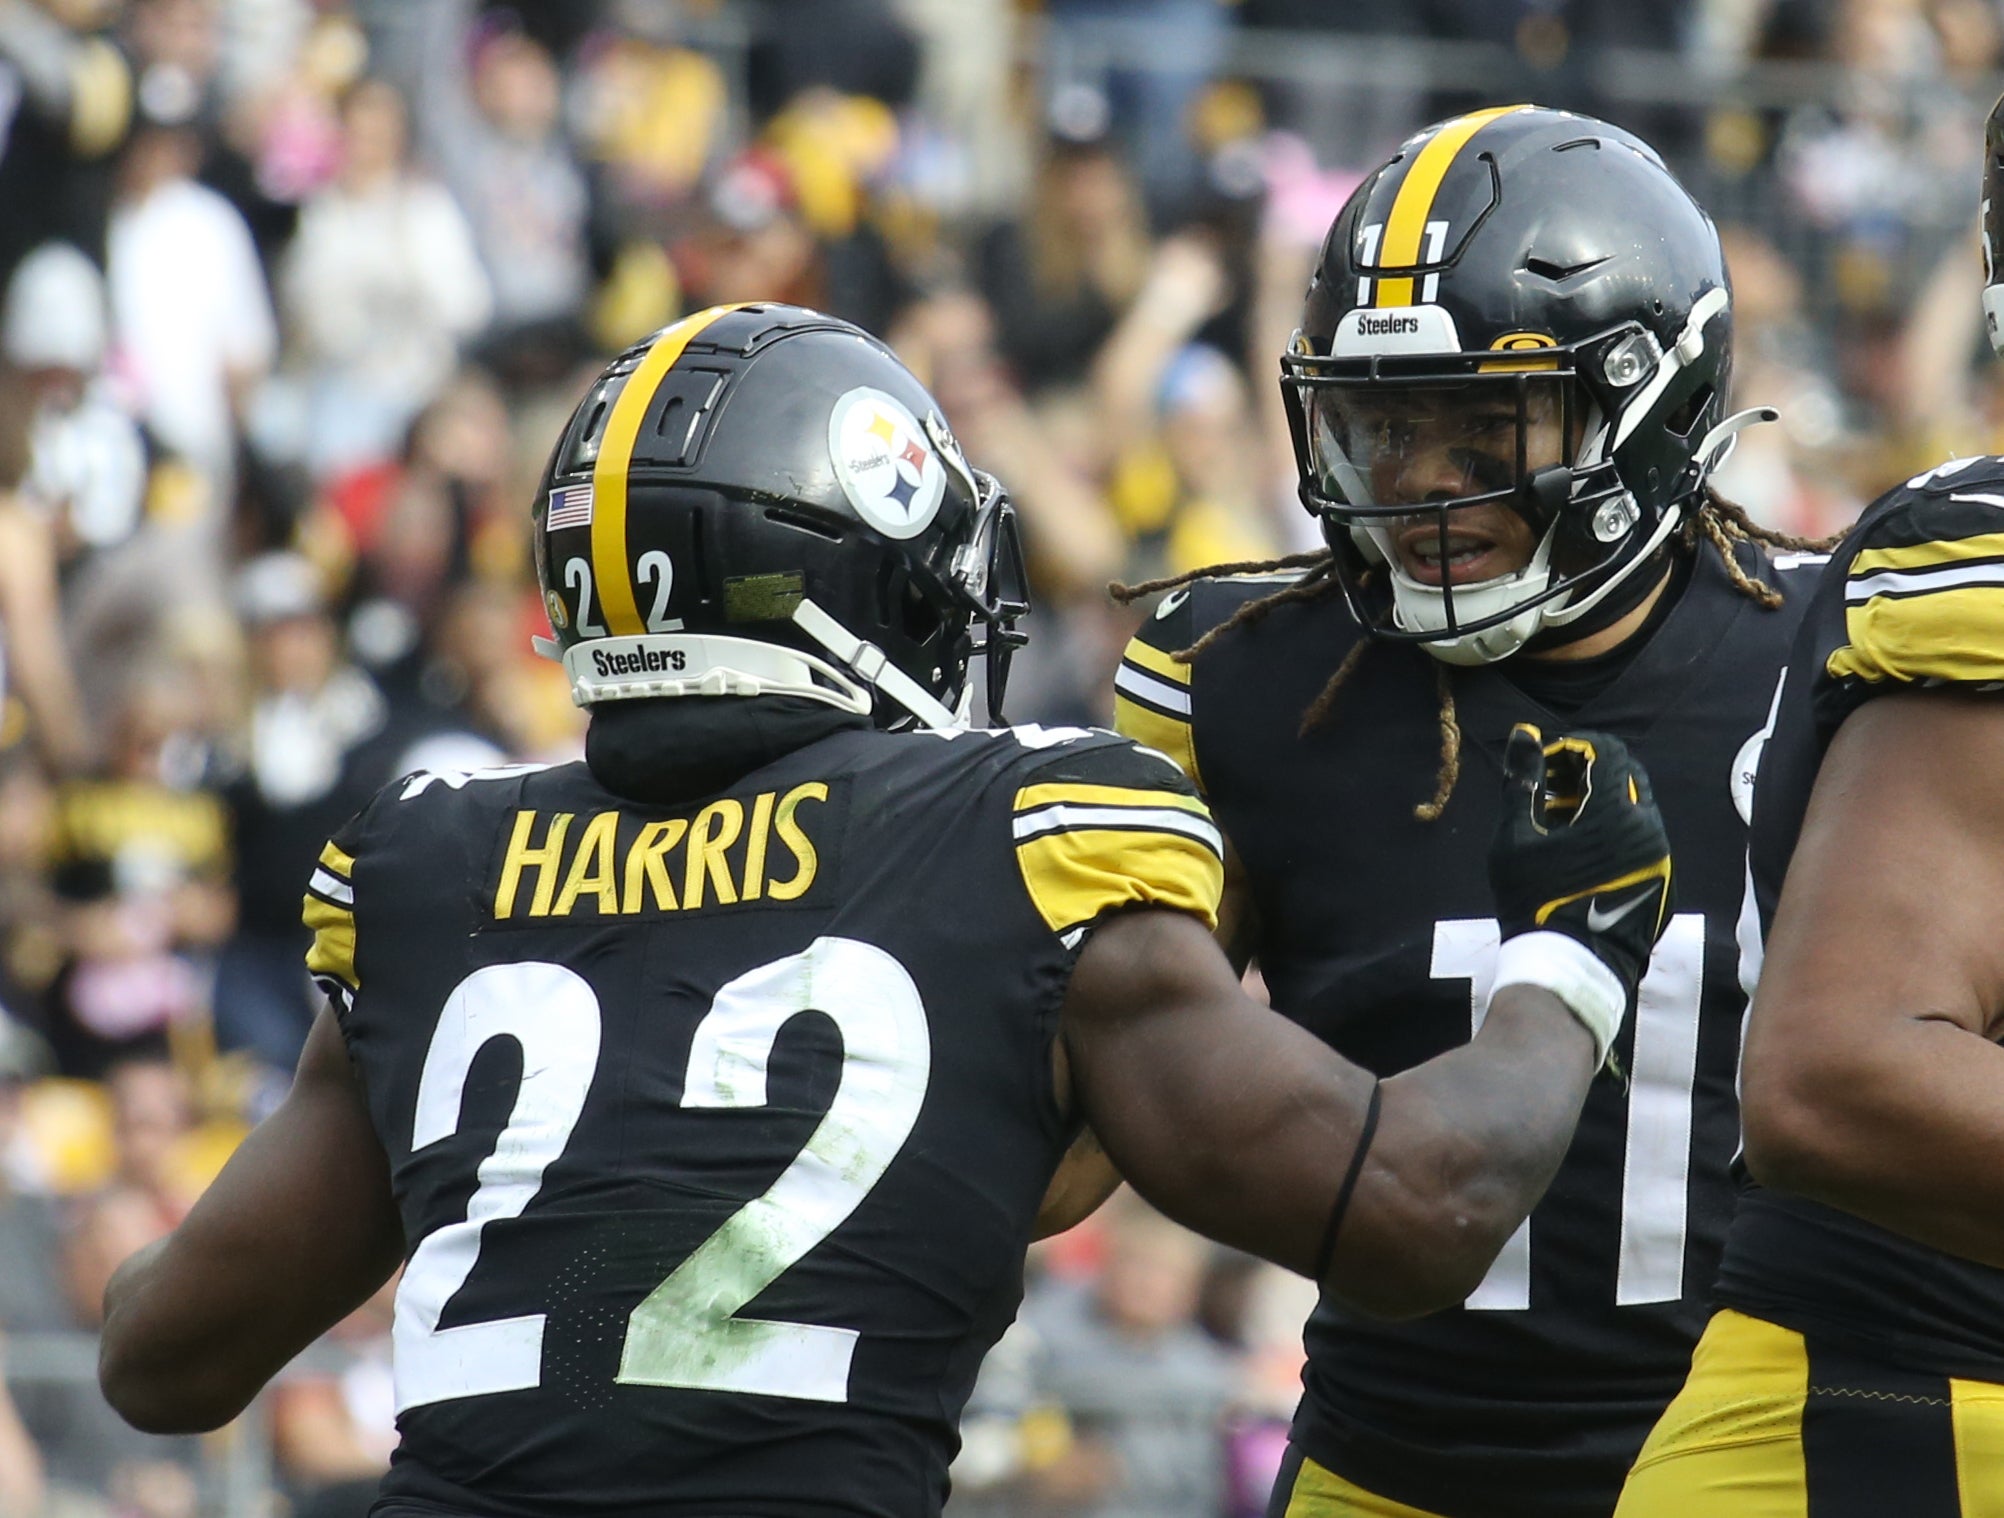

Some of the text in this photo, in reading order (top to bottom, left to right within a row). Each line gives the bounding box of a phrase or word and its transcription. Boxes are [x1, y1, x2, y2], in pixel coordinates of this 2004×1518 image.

[1357, 313, 1418, 336] Steelers
[848, 452, 890, 474] Steelers
[592, 644, 686, 677] Steelers
[494, 782, 828, 919] HARRIS
[394, 936, 931, 1416] 22
